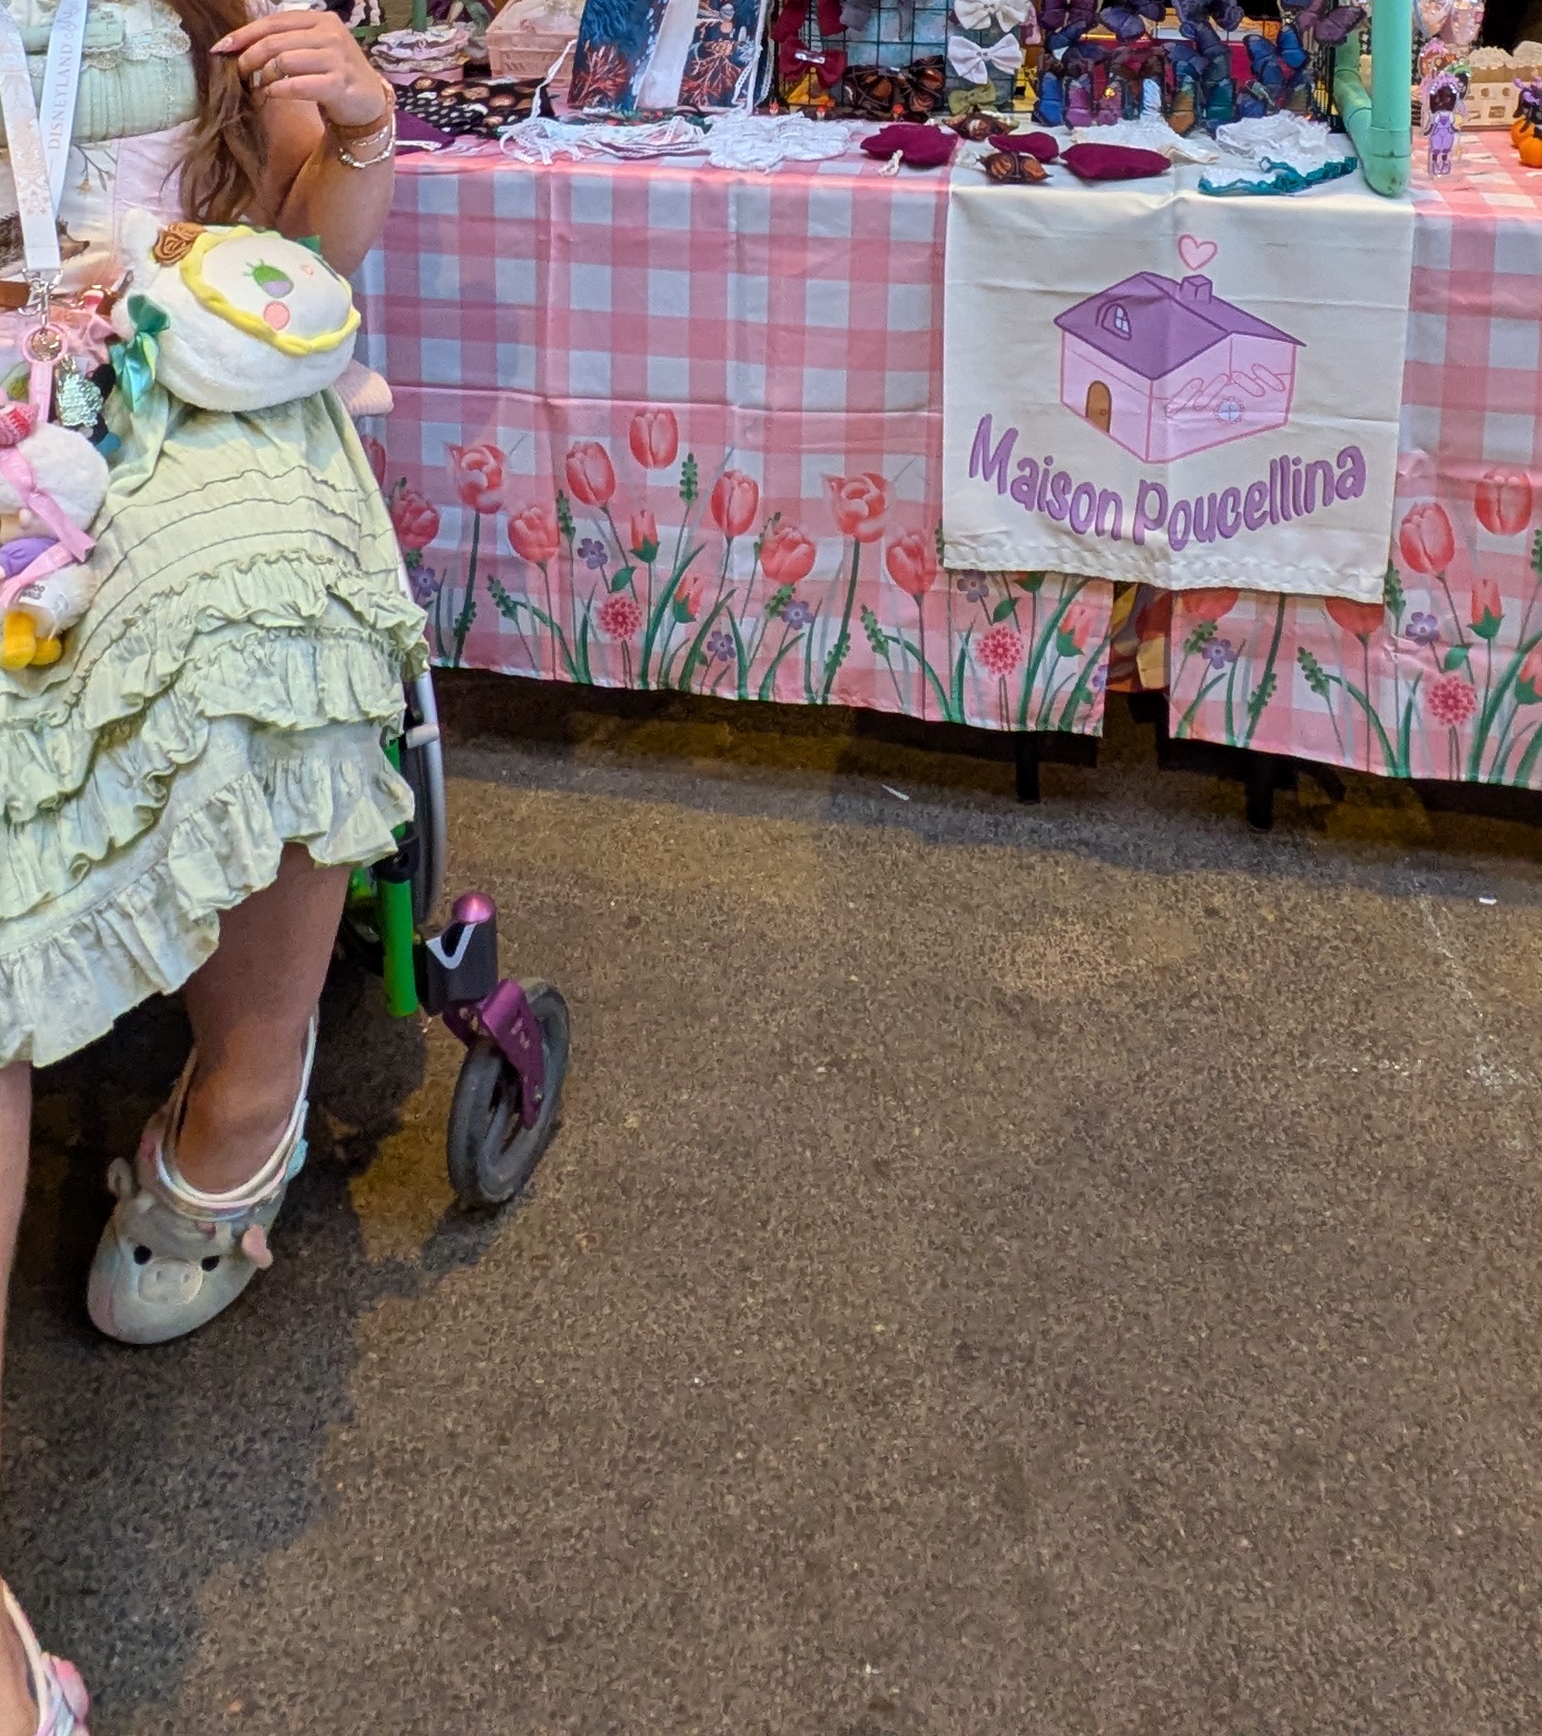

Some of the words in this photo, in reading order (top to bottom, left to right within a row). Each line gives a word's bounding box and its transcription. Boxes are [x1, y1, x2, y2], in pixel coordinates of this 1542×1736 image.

[47, 40, 74, 150] DISNEYLAND
[967, 413, 1123, 542] Maison
[1132, 444, 1367, 552] Poucellina
